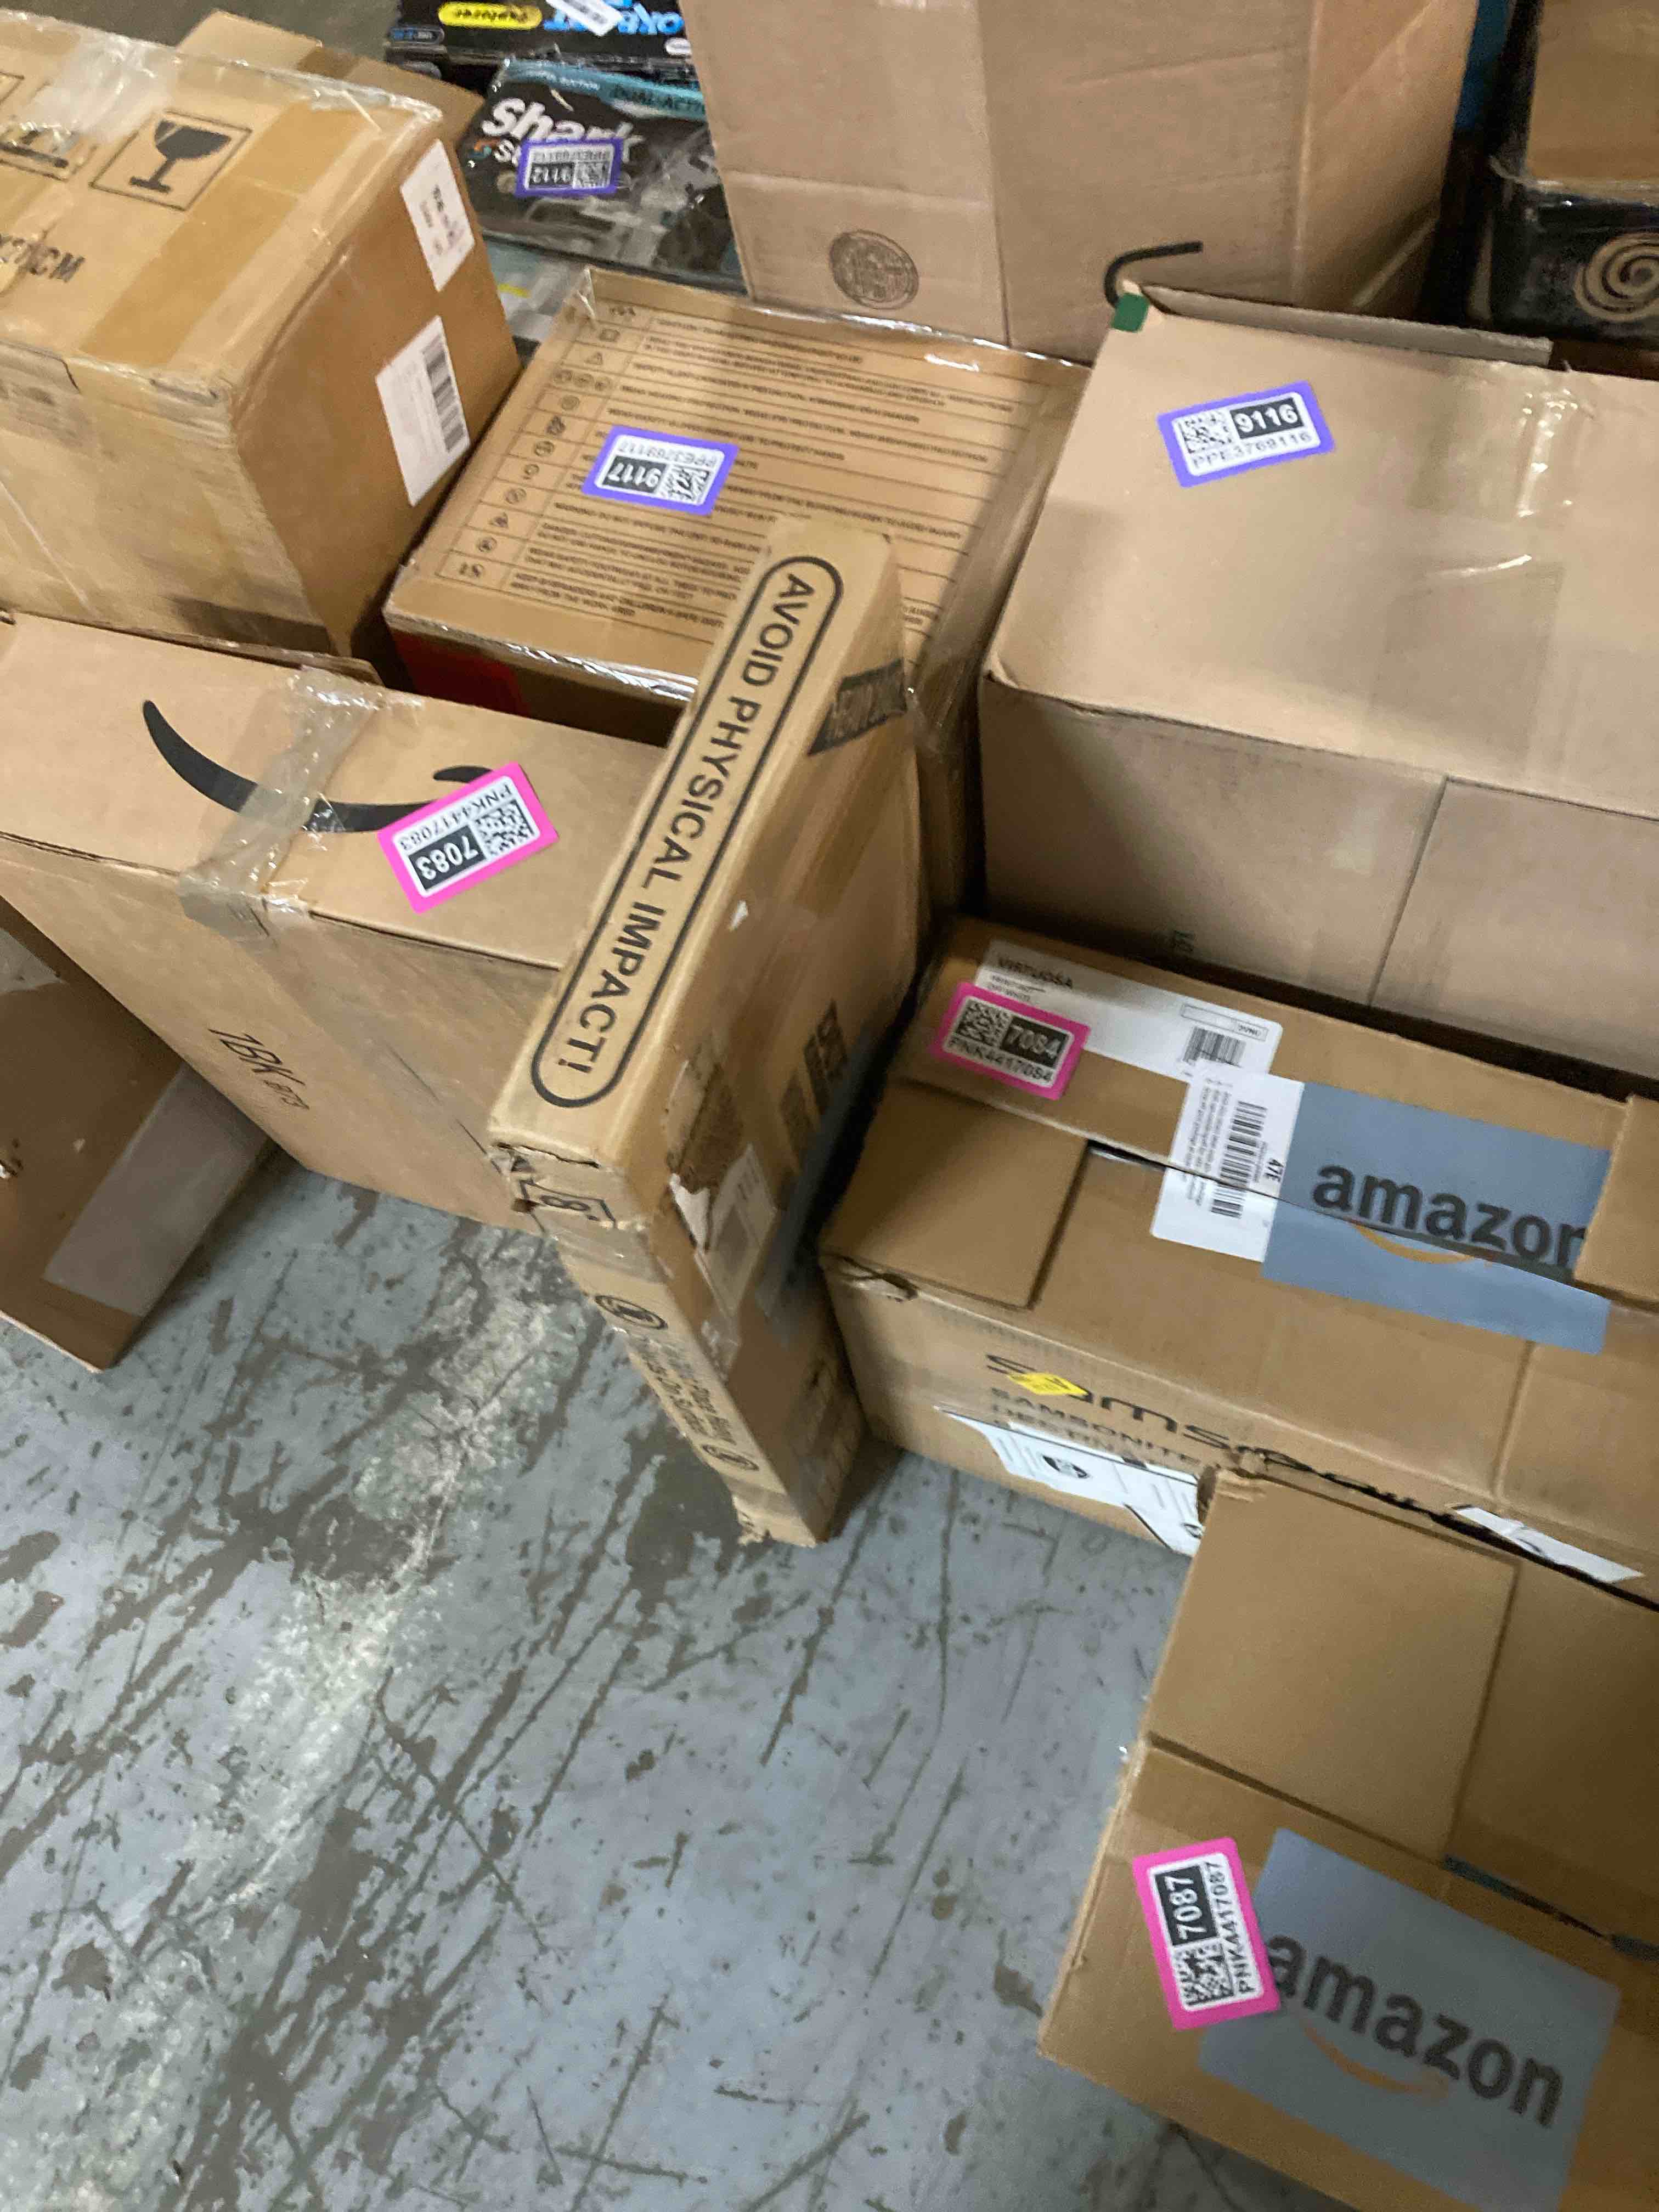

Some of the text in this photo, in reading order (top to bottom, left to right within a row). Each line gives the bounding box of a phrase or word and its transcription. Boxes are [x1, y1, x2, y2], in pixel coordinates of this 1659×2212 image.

[1234, 403, 1299, 433] 9116
[607, 461, 661, 488] 9117
[1193, 431, 1313, 469] PPE3769116
[398, 785, 514, 849] PNK4417083
[557, 573, 812, 1074] AVOID PHYSICAL IMPACT!
[416, 837, 478, 881] 7083
[1008, 1024, 1060, 1059] 7084
[1175, 1872, 1205, 1940] 7087
[1207, 1861, 1256, 1994] PNK4417087
[1267, 1934, 1566, 2129] amazon
